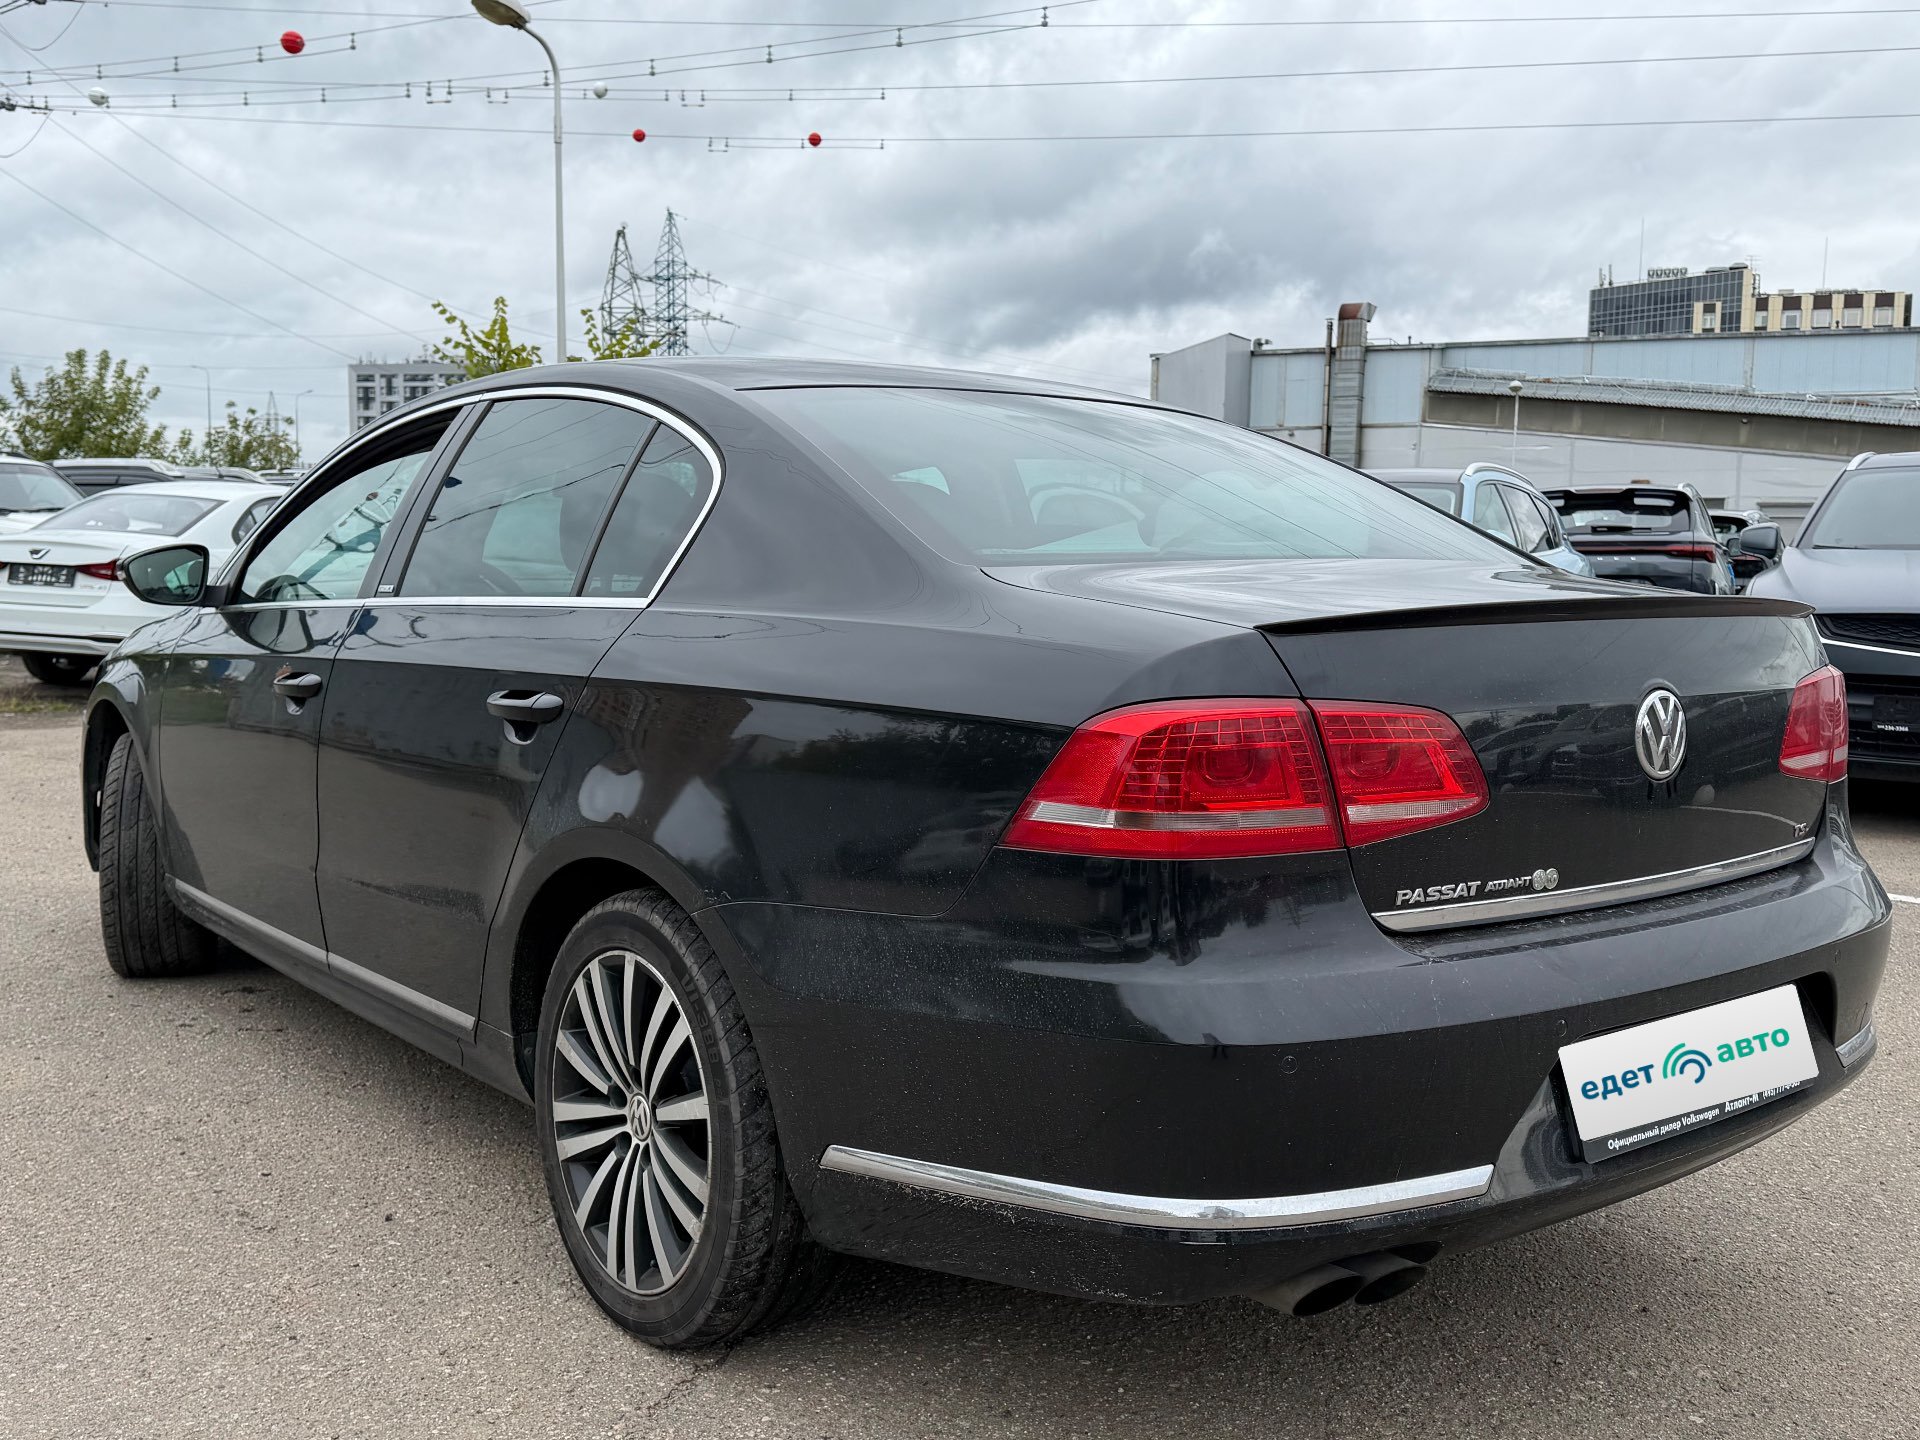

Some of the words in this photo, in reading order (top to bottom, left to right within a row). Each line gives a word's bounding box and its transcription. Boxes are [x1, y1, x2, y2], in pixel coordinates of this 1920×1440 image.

[1396, 881, 1481, 906] PASSAT
[1484, 876, 1532, 893] АТЛАНТ
[1607, 1126, 1660, 1150] Официальный
[1660, 1120, 1681, 1135] дилер
[1681, 1108, 1720, 1126] Volkswagen
[1724, 1093, 1760, 1112] Атлант-М
